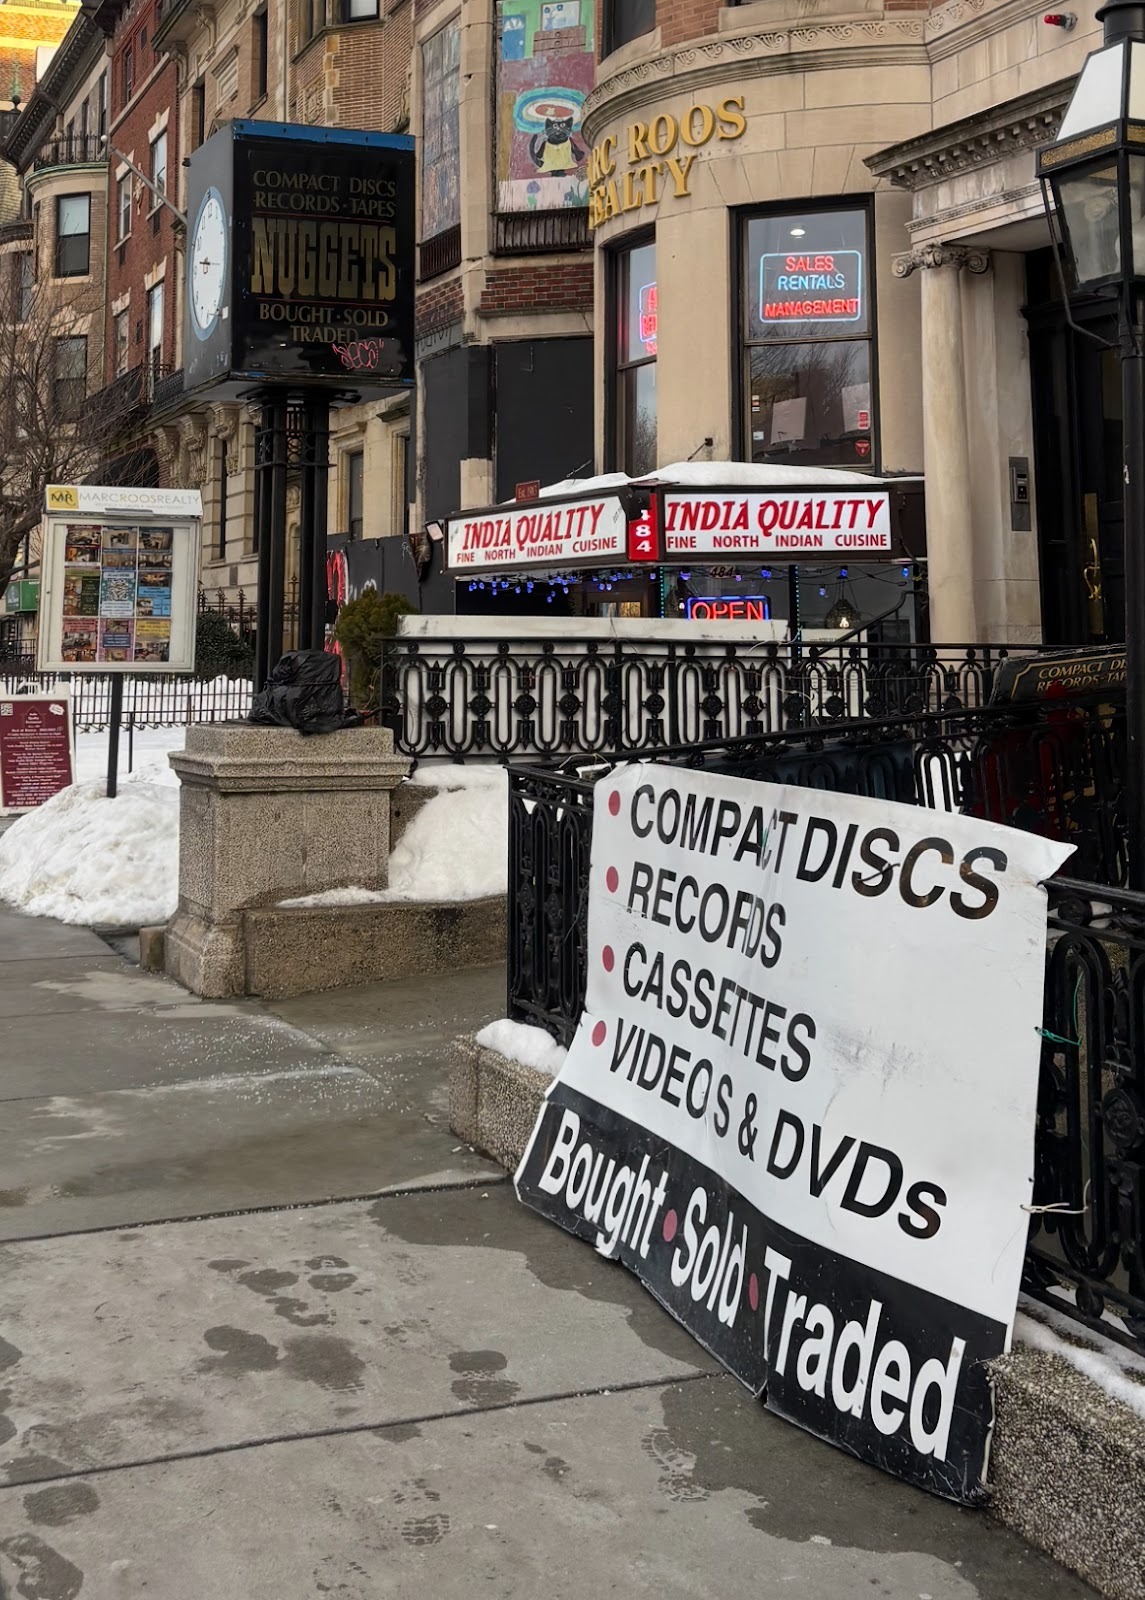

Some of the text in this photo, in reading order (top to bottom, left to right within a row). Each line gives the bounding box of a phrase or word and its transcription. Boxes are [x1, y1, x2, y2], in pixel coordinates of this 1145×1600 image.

[627, 95, 747, 165] ROOS
[253, 170, 396, 198] COMPACT DISCS
[254, 191, 396, 218] RECORDS TAPES
[251, 217, 396, 301] NUGGETS
[785, 255, 835, 272] SALES
[777, 273, 845, 291] RENTALS
[259, 303, 388, 327] BOUGHT SOLD
[764, 298, 859, 318] MANAGEMENT
[462, 517, 511, 550] INDIA
[516, 503, 605, 551] QUALITY
[665, 498, 749, 531] INDIA
[757, 498, 885, 537] QUALITY
[456, 536, 617, 563] FINE NORTH INDIAN CUISINE
[667, 534, 887, 549] FINE NORTH INDIAN CUISINE
[709, 566, 734, 577] 484
[692, 600, 764, 620] OPEN
[1038, 661, 1105, 679] COMPACT
[630, 784, 1009, 920] COMPACT DISCS
[627, 861, 786, 968] RECORDS
[623, 942, 816, 1082] CASSETTES
[609, 1017, 947, 1240] VIDEOS & DVDs
[538, 1108, 967, 1462] Bought Sold Traded
